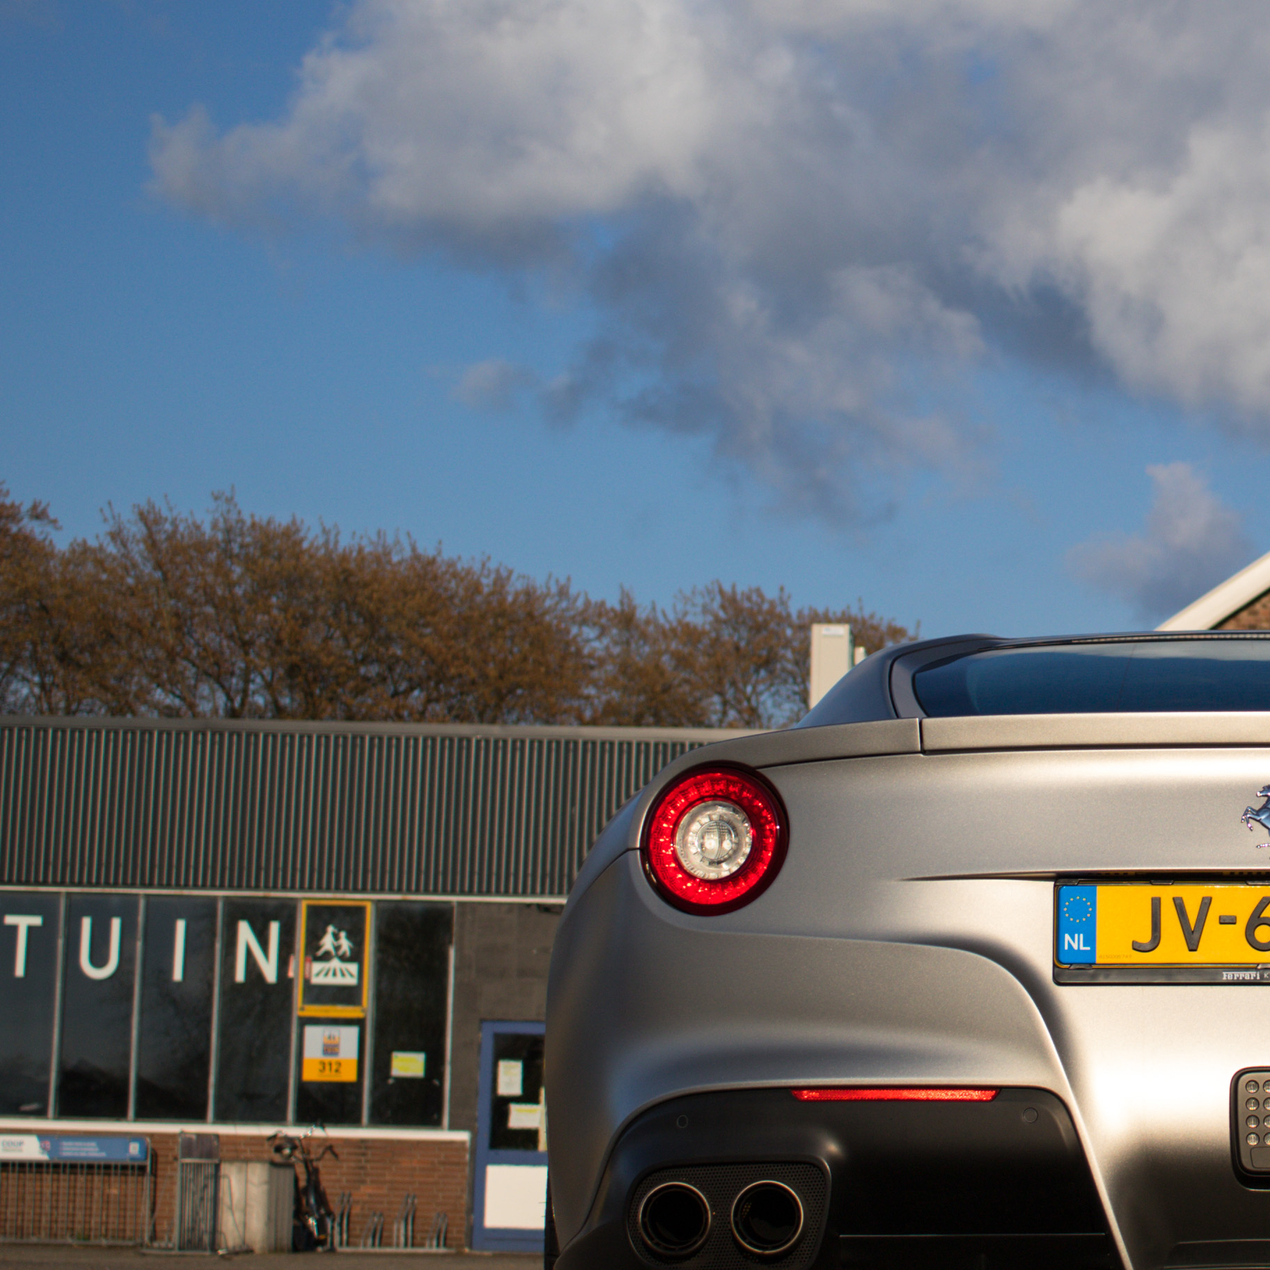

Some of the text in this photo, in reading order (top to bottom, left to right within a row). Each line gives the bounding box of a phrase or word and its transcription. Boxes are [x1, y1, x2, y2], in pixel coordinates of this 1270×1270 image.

[4, 915, 281, 985] TUIN
[1063, 933, 1091, 951] NL
[1222, 971, 1261, 981] Ferrari
[318, 1060, 342, 1074] 312
